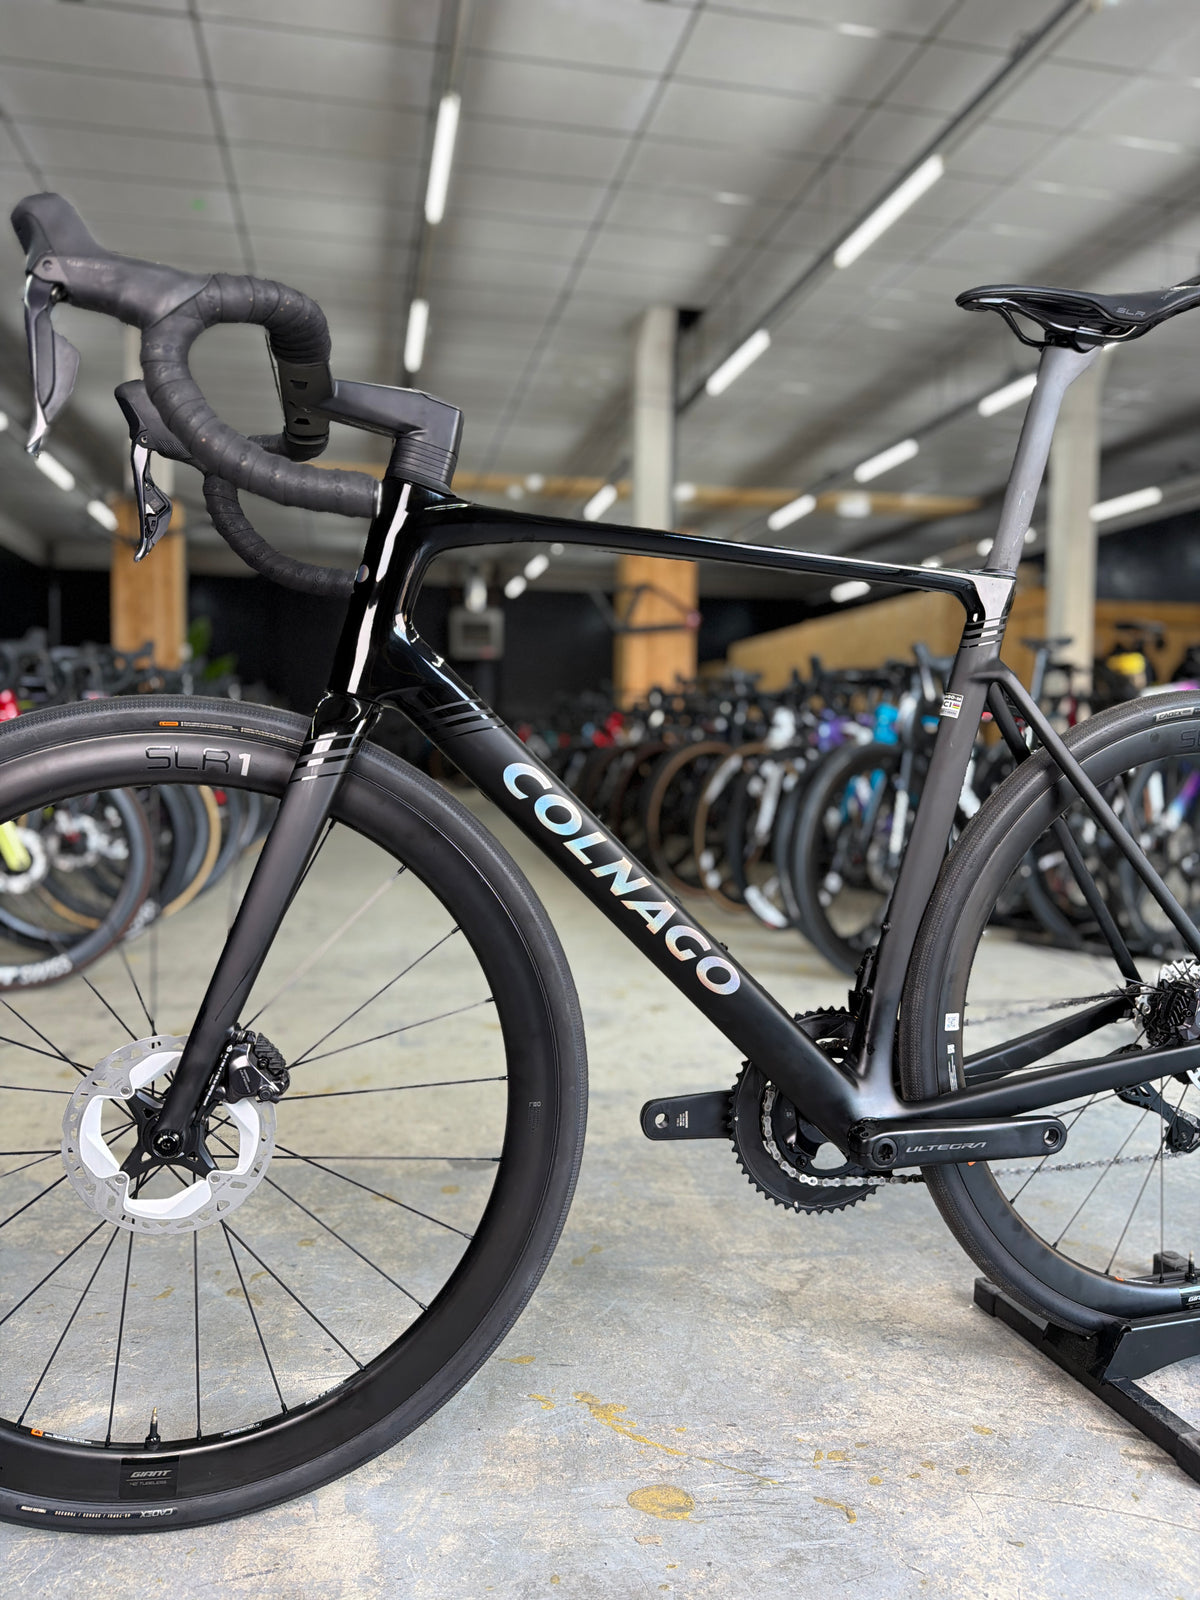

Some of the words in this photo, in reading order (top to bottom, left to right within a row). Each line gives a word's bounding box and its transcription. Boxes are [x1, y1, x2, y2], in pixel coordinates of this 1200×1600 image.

[1116, 307, 1146, 318] SLR
[502, 762, 742, 996] COLNAGO
[905, 1141, 987, 1153] ULTEGRA
[130, 1469, 173, 1478] GIANT
[140, 1507, 175, 1519] CADEX
